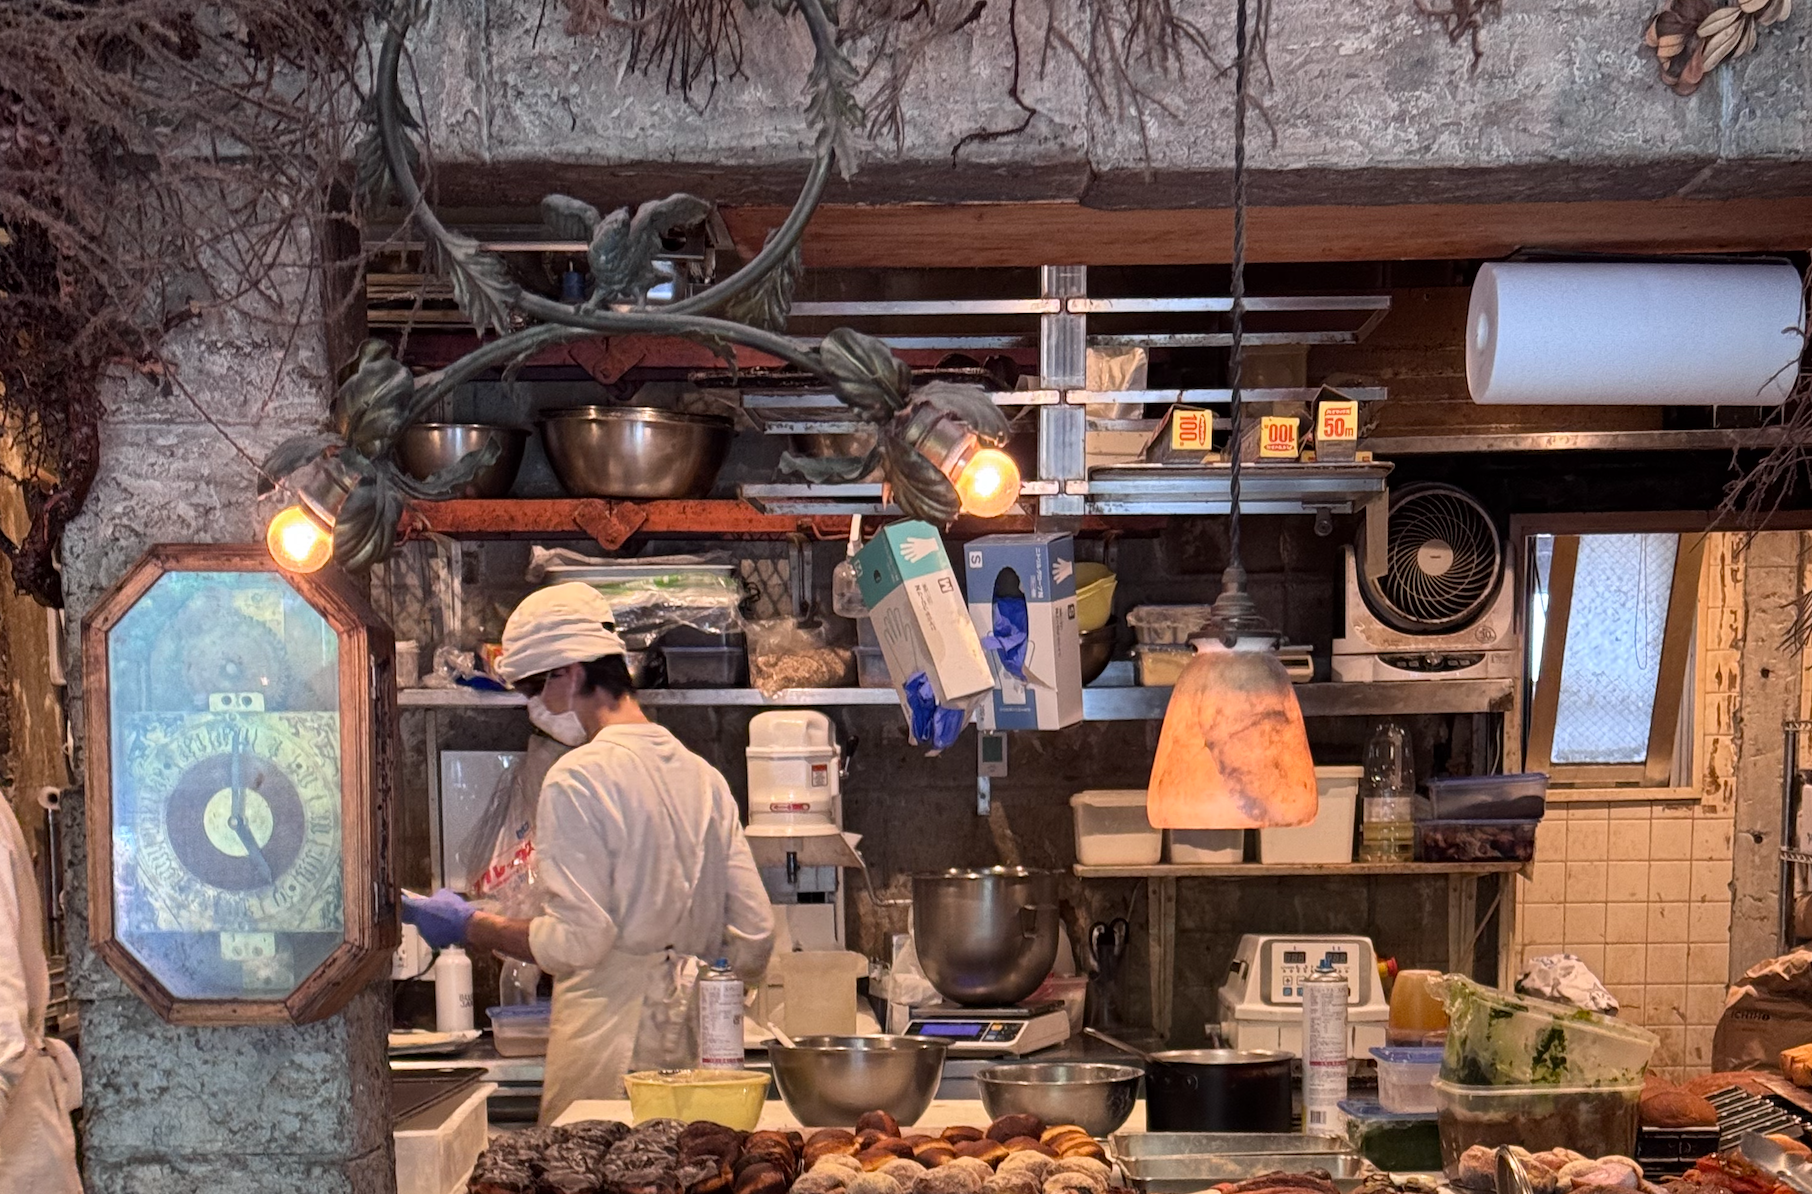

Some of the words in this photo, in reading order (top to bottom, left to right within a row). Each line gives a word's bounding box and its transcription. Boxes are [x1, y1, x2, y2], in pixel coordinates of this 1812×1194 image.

[1323, 417, 1354, 438] 50m
[971, 554, 981, 565] S
[938, 577, 953, 593] M
